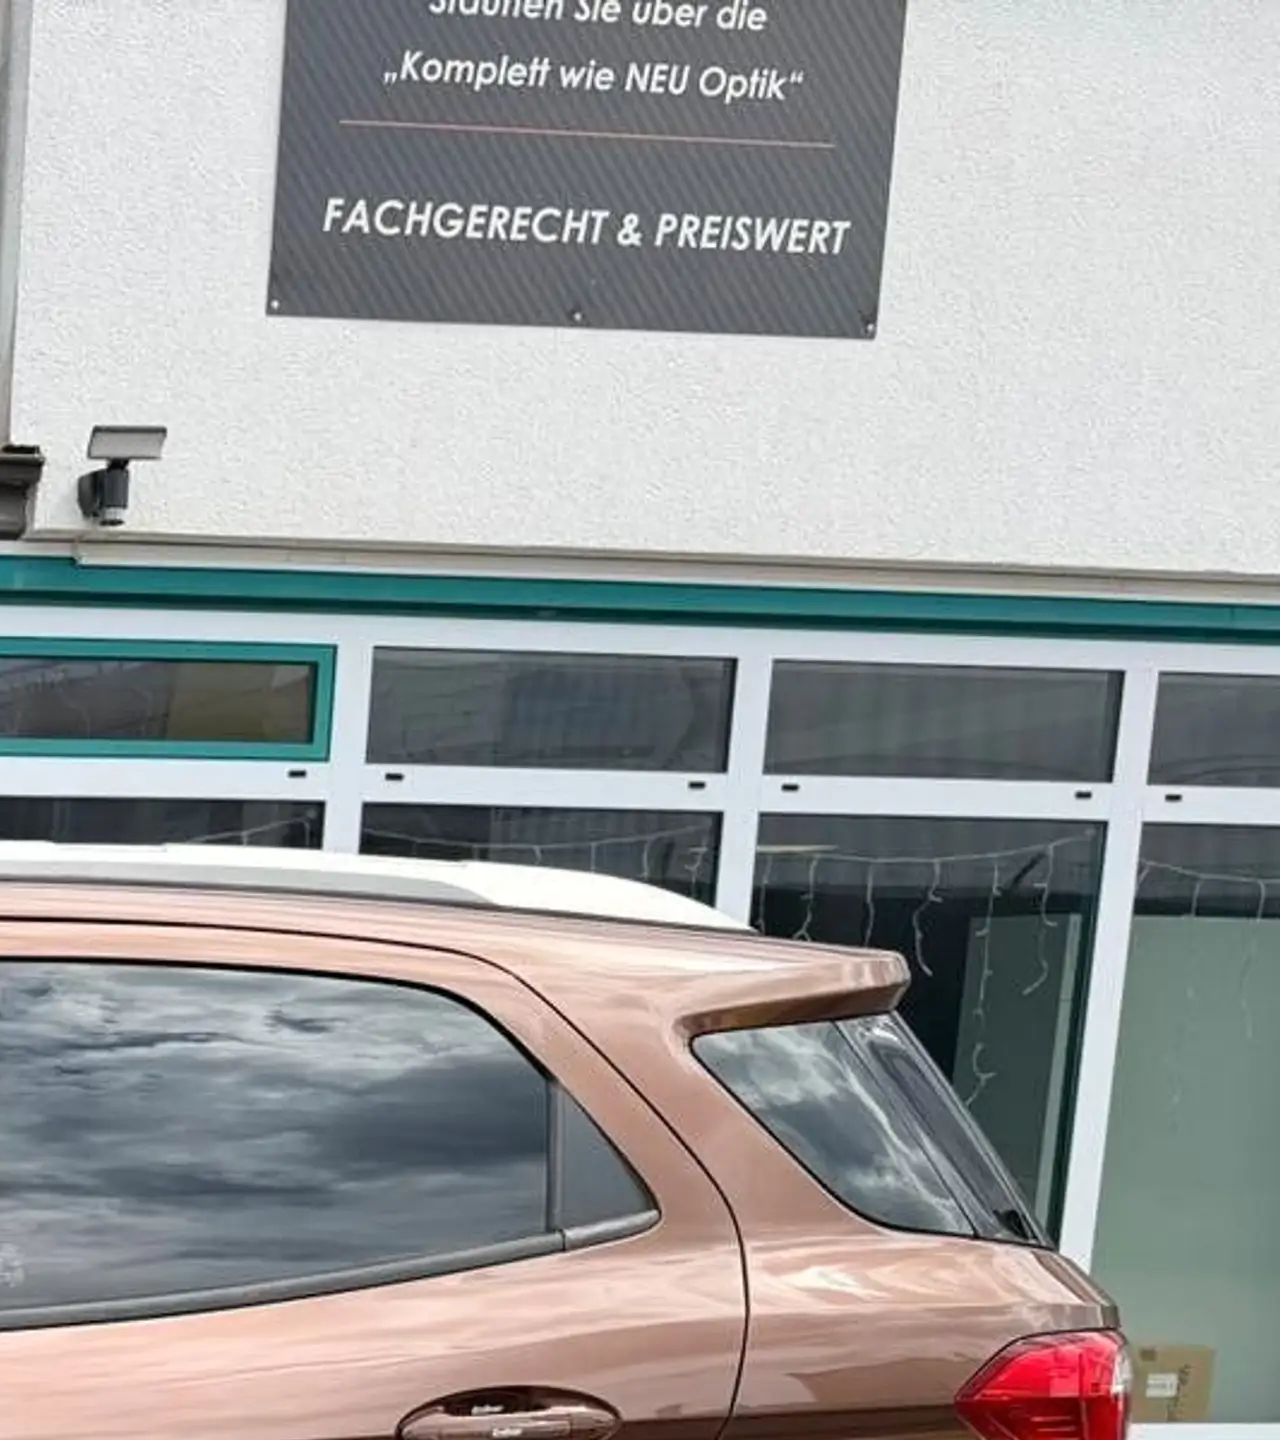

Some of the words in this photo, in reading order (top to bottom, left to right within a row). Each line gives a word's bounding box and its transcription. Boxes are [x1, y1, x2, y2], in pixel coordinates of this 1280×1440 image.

[716, 0, 768, 31] die
[559, 59, 615, 91] wie
[624, 62, 691, 95] NEU
[322, 197, 611, 244] FACHGERECHT
[616, 212, 642, 246] &
[654, 213, 852, 255] PREISWERT
